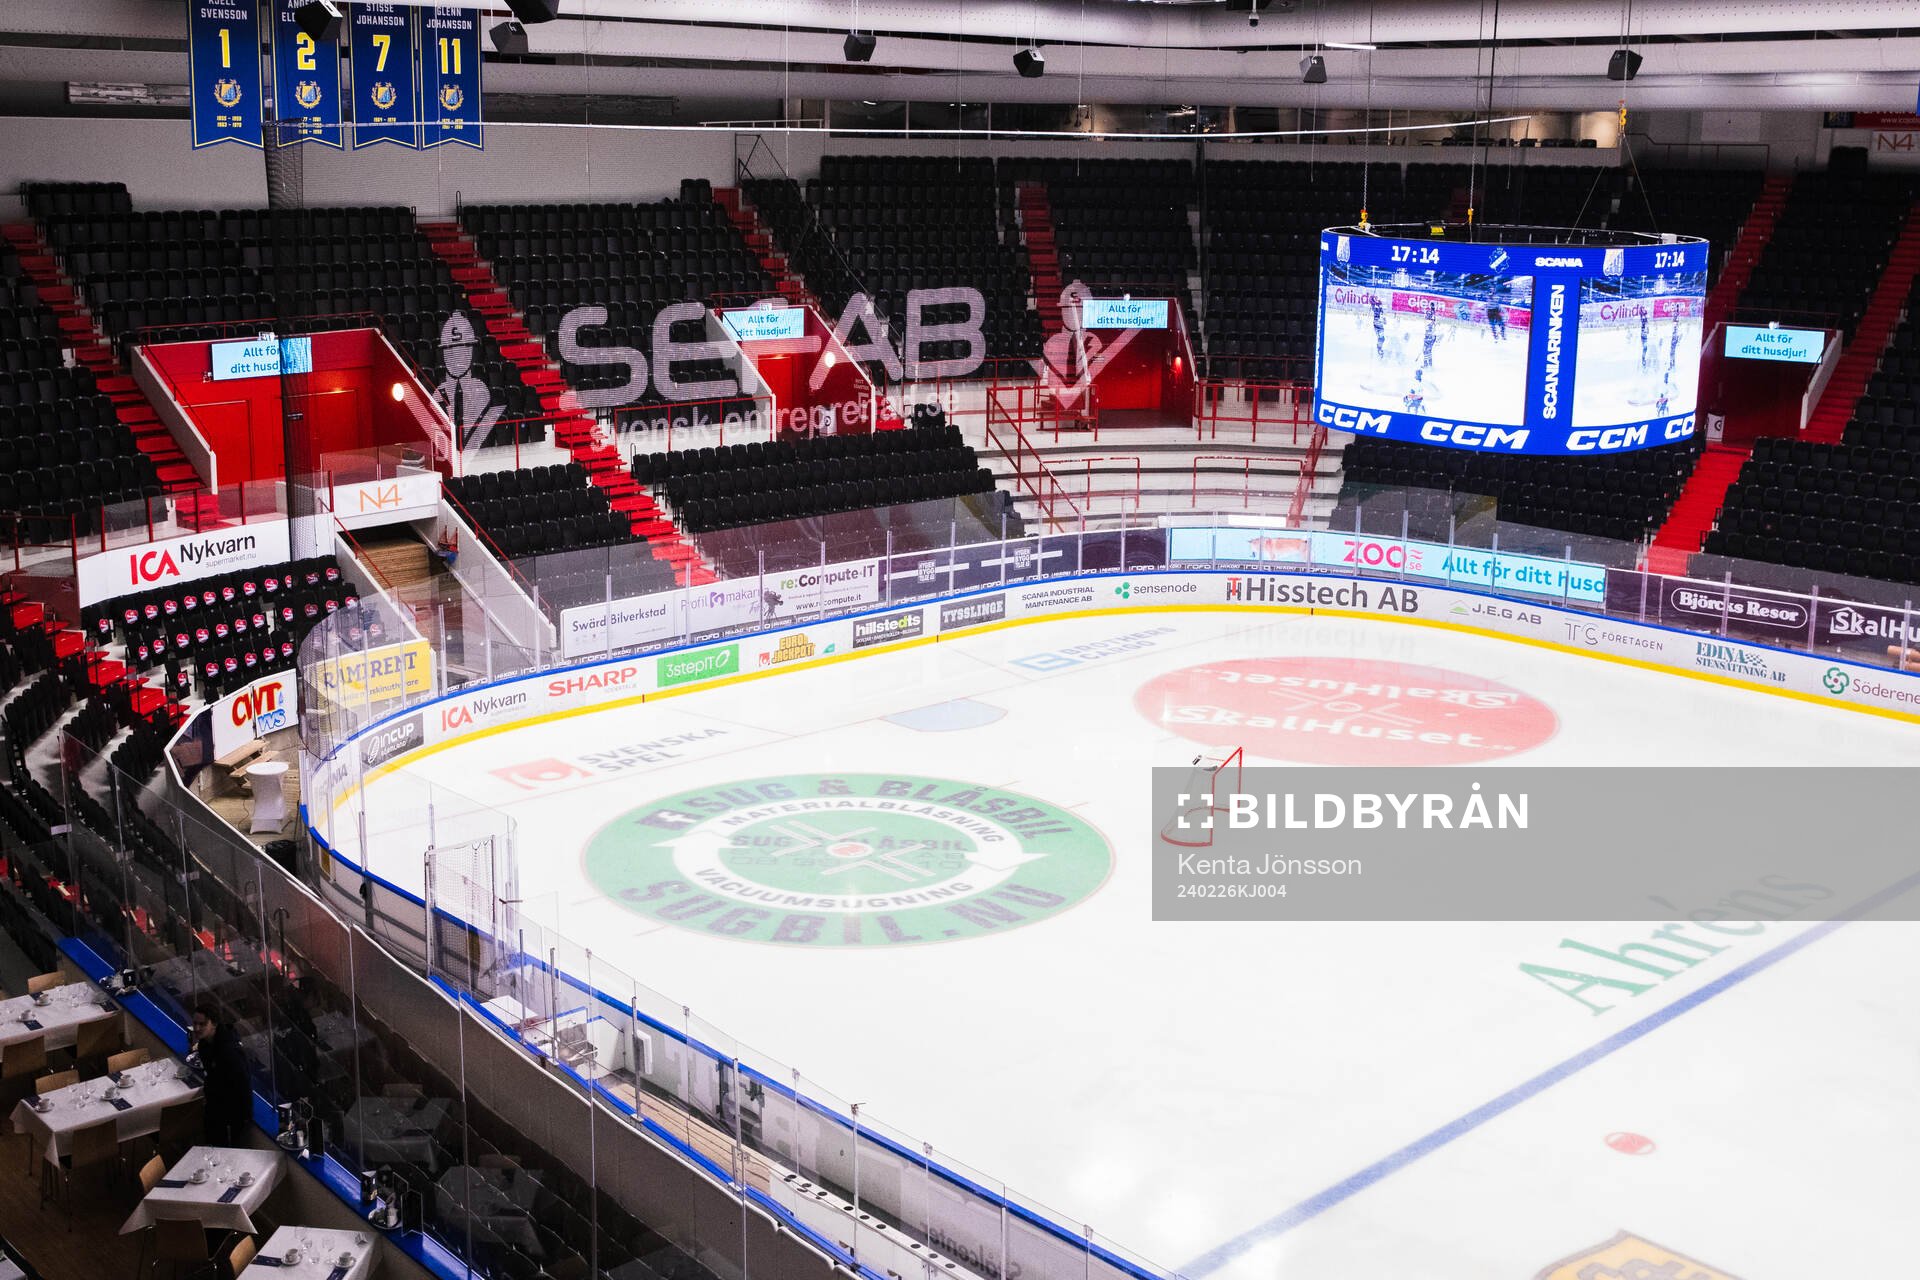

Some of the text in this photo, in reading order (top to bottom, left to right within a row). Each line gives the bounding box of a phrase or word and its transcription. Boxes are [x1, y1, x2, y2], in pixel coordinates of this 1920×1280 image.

[200, 8, 248, 20] SVENSSON
[366, 3, 394, 13] STISSE
[356, 15, 405, 26] JOHANSSON
[426, 19, 473, 30] JOHANSSON
[218, 29, 231, 68] 1
[296, 32, 317, 70] 2
[372, 34, 391, 72] 7
[438, 38, 461, 75] 11
[1390, 245, 1440, 265] 17:14
[1534, 257, 1584, 268] SCANIA
[1654, 251, 1685, 269] 17:14
[748, 314, 779, 324] Allt för
[1108, 305, 1141, 313] Allt för
[1097, 316, 1154, 326] ditt husdjur!
[737, 327, 791, 338] ditt husdjur!
[1755, 333, 1793, 345] Allt för
[243, 347, 263, 357] Allt
[1543, 284, 1565, 420] SCANIARINKEN
[1741, 344, 1807, 359] ditt husdjur!
[230, 363, 251, 374] ditt
[1318, 403, 1392, 434] CCM
[1420, 421, 1530, 449] CCM
[1566, 424, 1649, 451] CCM
[358, 484, 403, 512] N4
[130, 533, 257, 585] ICA Nykvarn
[205, 552, 257, 569] supermarket.nu
[1441, 555, 1477, 577] Allt
[1482, 558, 1510, 582] för
[1515, 566, 1552, 586] ditt
[1022, 586, 1095, 601] SCANIA INDUSTRIAL
[1133, 582, 1197, 594] sensenode
[1246, 577, 1418, 613] Hisstech AB
[942, 601, 1004, 623] TYSSLINGE
[1025, 595, 1093, 609] MAINTENANCE AB
[1679, 591, 1798, 623] Björcks Resor
[572, 604, 667, 632] Swärd Bilverkstad
[855, 614, 920, 637] hillstedts
[1472, 604, 1542, 625] J.E.G AB
[780, 633, 805, 650] EURO
[1058, 627, 1177, 656] BROTHERS
[1080, 640, 1157, 660] CARGO
[1696, 641, 1748, 663] EDINA
[772, 642, 815, 664] JACKPOT
[666, 656, 712, 678] 3stepIT
[1770, 670, 1786, 682] AB
[548, 667, 637, 697] SHARP
[231, 681, 283, 727] CWT
[442, 705, 473, 732] ICA
[473, 693, 527, 715] Nykvarn
[257, 708, 287, 734] VVS
[579, 727, 729, 766] SVENSKA
[597, 750, 684, 773] SPEL
[688, 778, 1073, 841] SUG & BLÅSBIL
[722, 798, 1007, 845] MATERIALBLÅSNING
[694, 868, 975, 910] VACUUMSUGNING
[619, 879, 1067, 946] SUGBIL.NU
